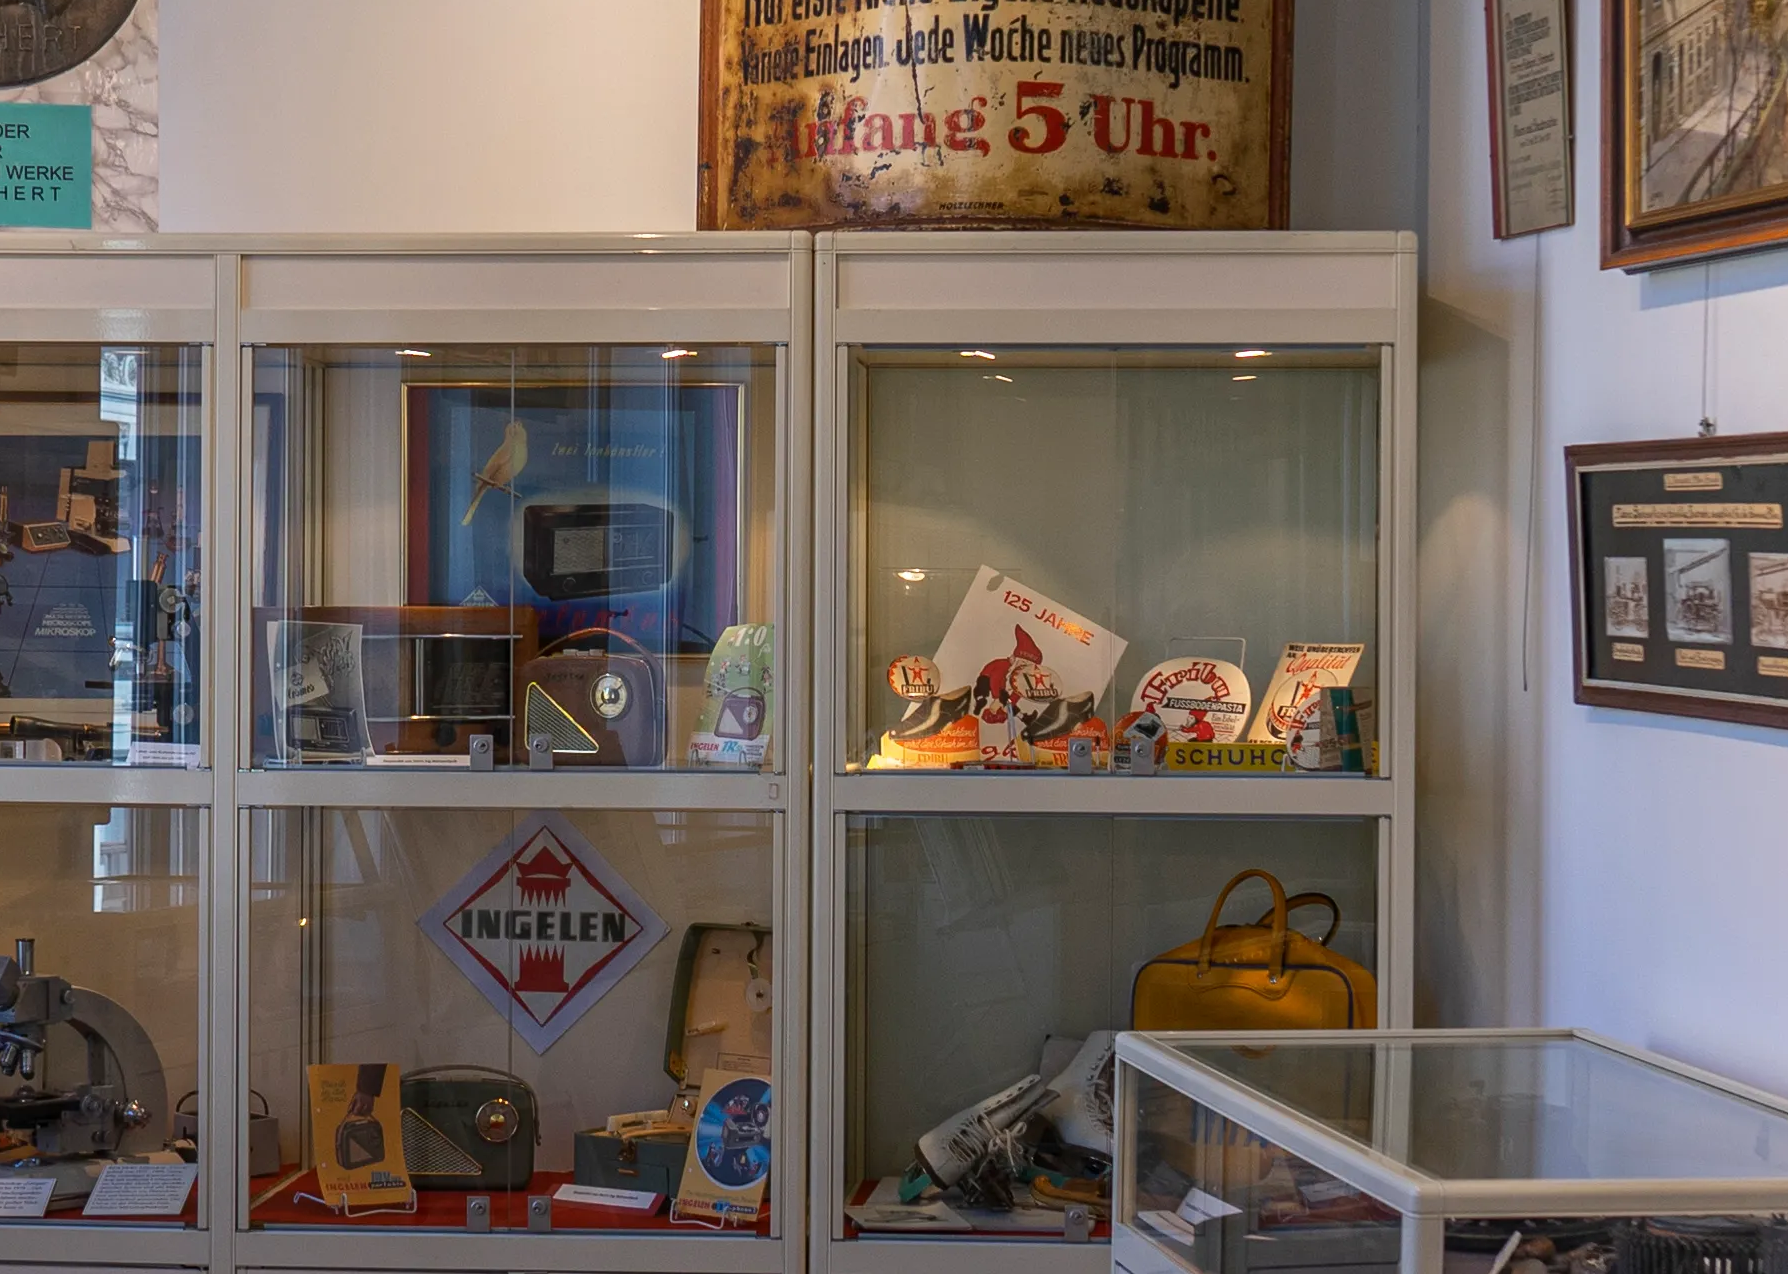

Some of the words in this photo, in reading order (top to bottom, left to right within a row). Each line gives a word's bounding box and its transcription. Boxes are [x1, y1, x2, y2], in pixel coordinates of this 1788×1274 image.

[895, 15, 955, 67] Jede
[963, 14, 1052, 62] Woche
[1060, 28, 1126, 69] neues
[1132, 24, 1251, 90] Programm.
[1008, 81, 1067, 154] 5
[1091, 95, 1217, 163] Uhr.
[7, 164, 74, 181] WERKE
[1003, 589, 1033, 613] 125
[35, 627, 96, 636] MIKROSKOP
[1035, 608, 1095, 647] JAHRE
[1285, 652, 1352, 675] Qualität
[1168, 699, 1245, 713] FUSSBODENPASTA
[690, 740, 719, 751] INGELEN
[461, 909, 627, 944] INGELEN
[325, 1180, 369, 1191] INGELEN
[678, 1198, 711, 1210] INGELEN
